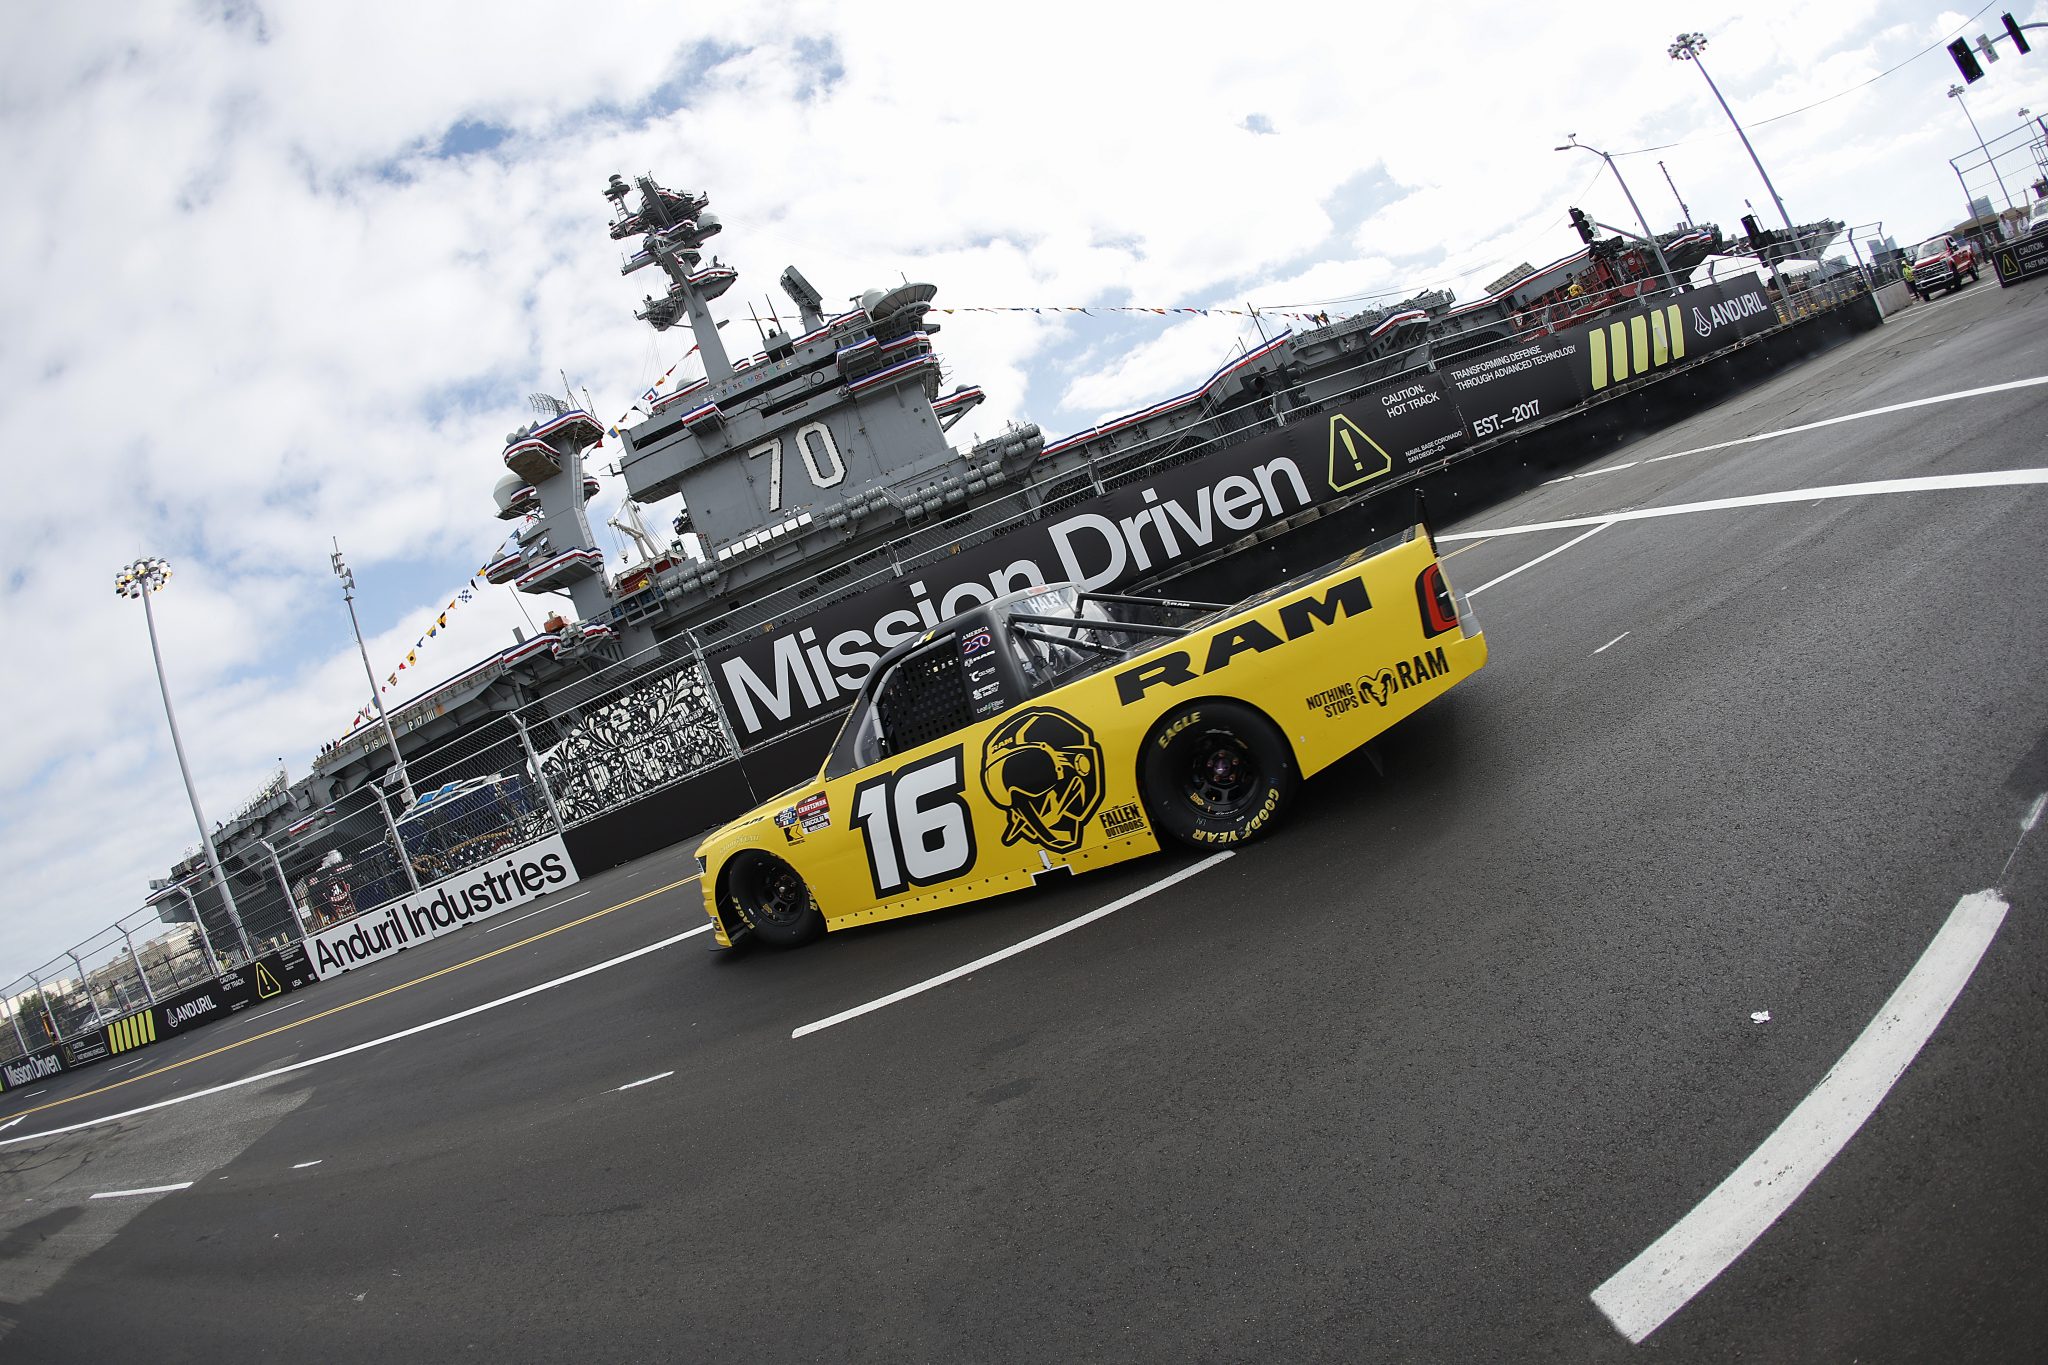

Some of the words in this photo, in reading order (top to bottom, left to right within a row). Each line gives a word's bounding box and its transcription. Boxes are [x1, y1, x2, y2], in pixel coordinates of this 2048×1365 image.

[1709, 291, 1768, 329] ANDURIL
[1451, 355, 1511, 381] TRANSFORMING
[1510, 345, 1542, 362] DEFENSE
[1456, 371, 1495, 391] THROUGH
[1495, 359, 1533, 379] ADVANCED
[1534, 345, 1577, 366] TECHNOLOGY
[1381, 384, 1426, 406] CAUTION:
[1386, 403, 1406, 418] HOT
[1407, 391, 1440, 410] TRACK
[1405, 448, 1422, 457] NAVAL
[1421, 442, 1435, 451] BASE
[1434, 430, 1463, 445] CORONADO
[748, 421, 847, 513] 70
[1407, 456, 1420, 464] SAN
[1048, 457, 1312, 593] Driven
[1027, 590, 1063, 613] HALEY
[962, 626, 989, 640] AMERICA
[962, 634, 991, 654] 250
[1114, 576, 1373, 706] RAM
[1395, 646, 1450, 689] RAM
[1306, 682, 1354, 710] NOTHING
[1324, 696, 1359, 718] STOPS
[992, 737, 1013, 750] RAM
[1158, 711, 1201, 749] EAGLE
[798, 798, 827, 814] CRAFTSMAN
[1099, 803, 1141, 829] FALLEN
[801, 815, 825, 828] LINCOLN
[853, 748, 974, 896] 16
[1105, 819, 1145, 838] OUTDOORS
[316, 908, 409, 974] Anduril
[401, 853, 568, 937] Industries
[731, 895, 755, 929] EAGLE
[222, 981, 232, 992] HOT
[231, 978, 246, 990] TRACK
[291, 979, 303, 987] USA
[176, 994, 217, 1023] ANDURIL
[4, 1062, 37, 1087] Mission
[29, 1054, 62, 1078] Driven
